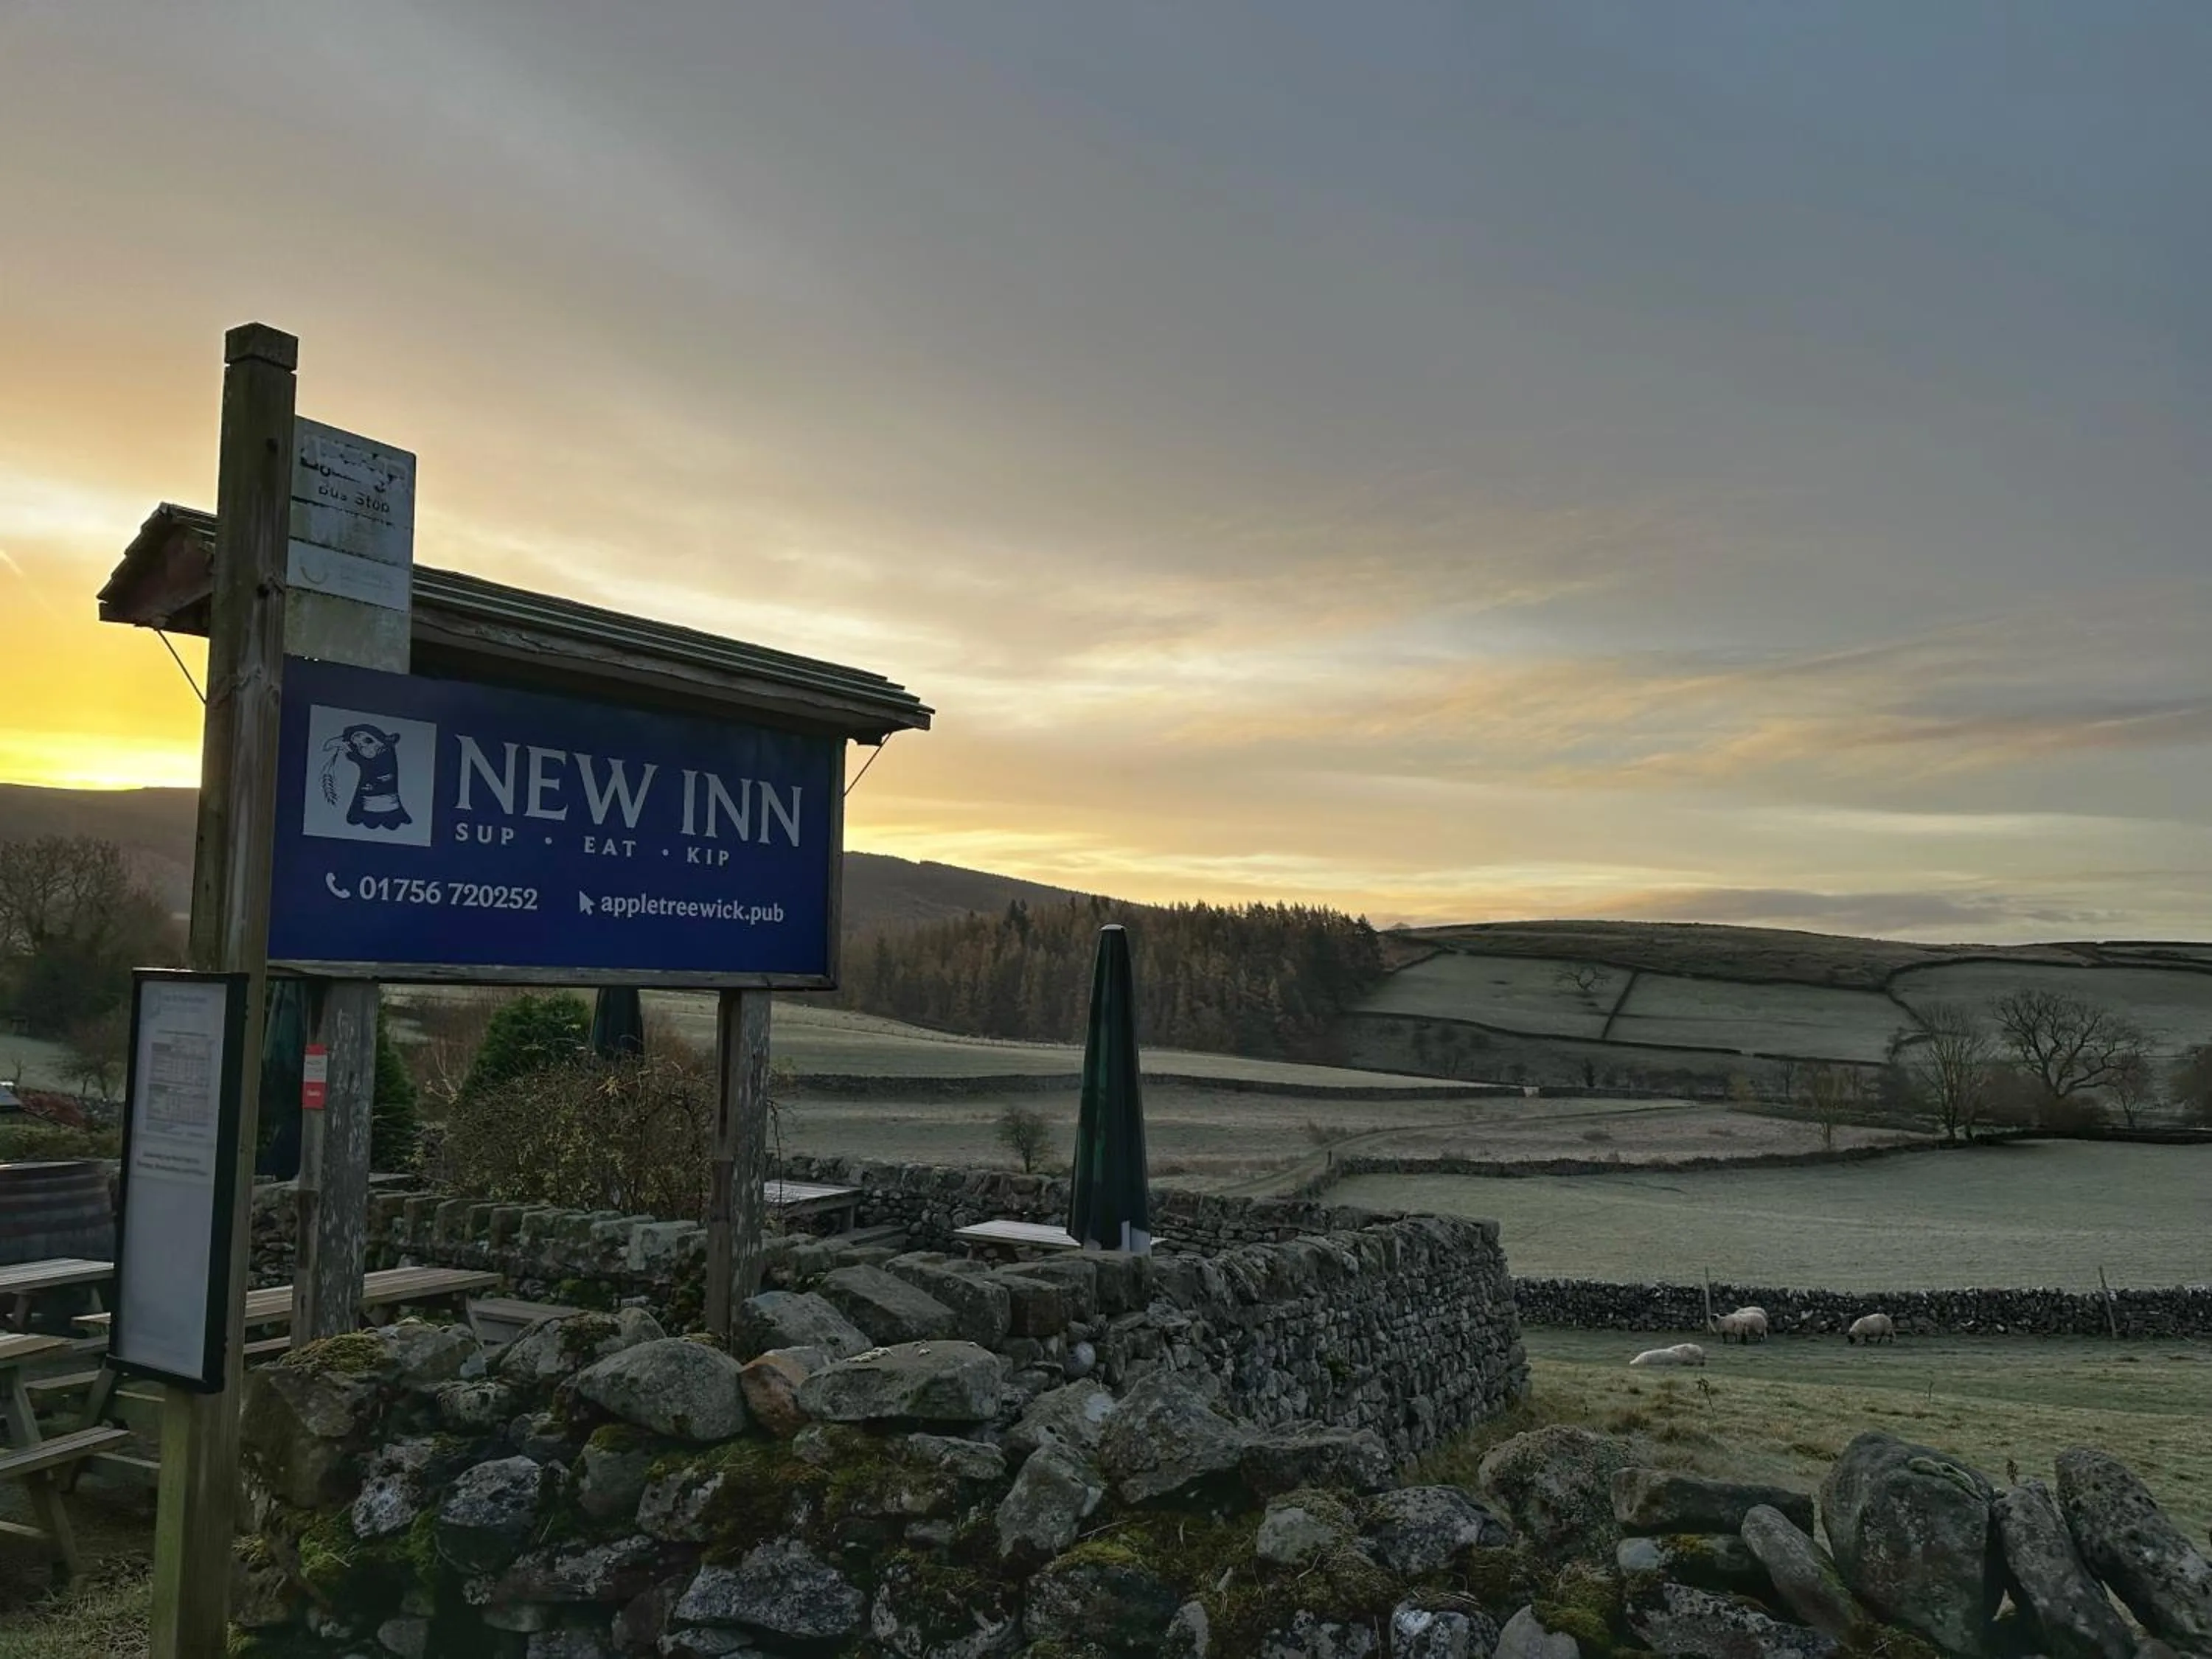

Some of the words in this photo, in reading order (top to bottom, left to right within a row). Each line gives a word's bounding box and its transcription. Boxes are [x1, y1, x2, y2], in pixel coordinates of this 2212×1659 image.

[454, 734, 658, 829] NEW
[681, 768, 804, 847] INN
[455, 822, 515, 845] SUP
[584, 836, 636, 858] EAT
[686, 846, 730, 866] KIP
[358, 875, 442, 905] 01756
[447, 883, 539, 911] 720252
[600, 892, 785, 925] appletreewick.pub
